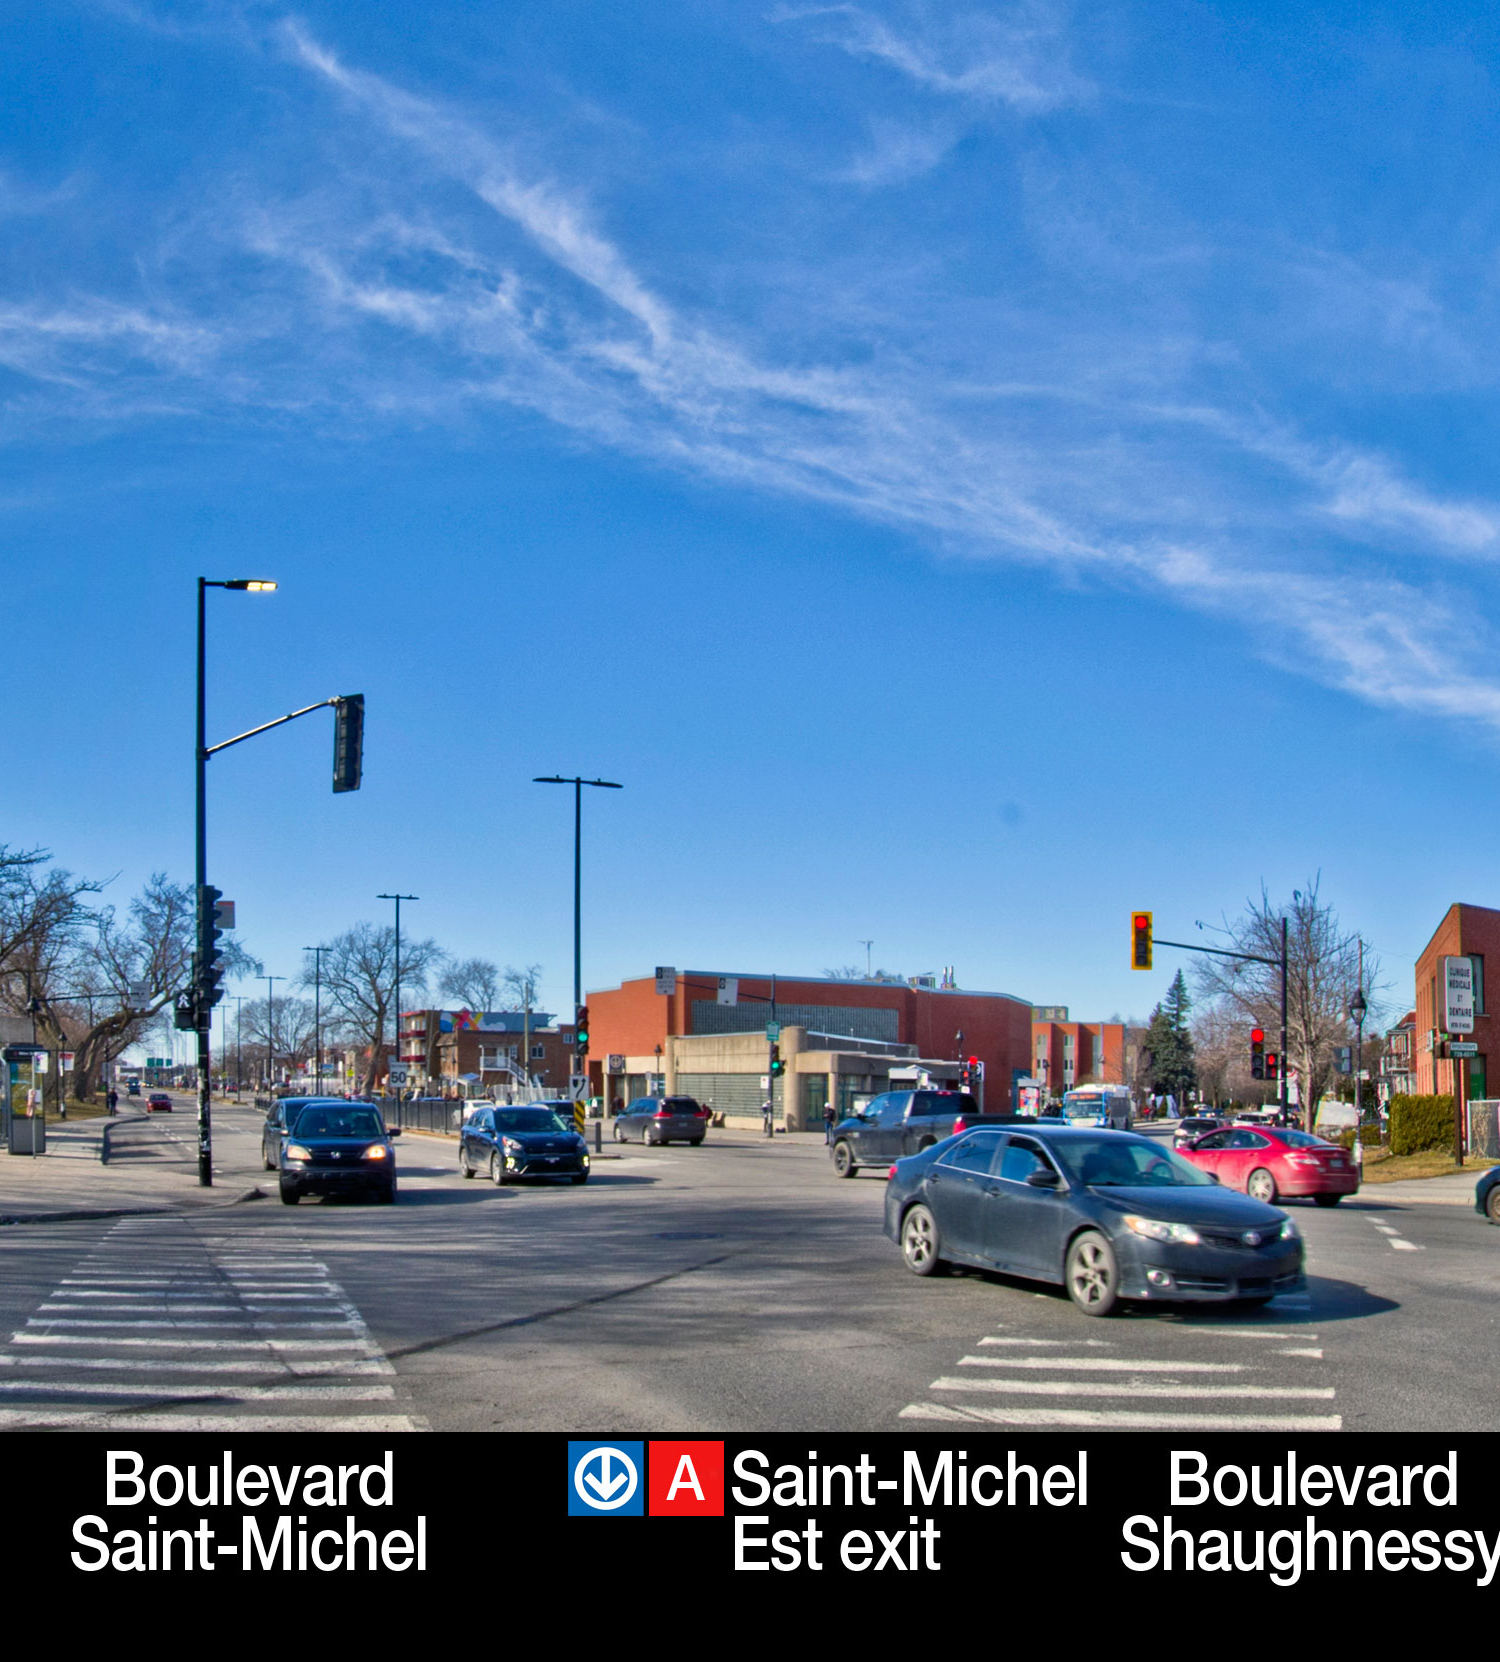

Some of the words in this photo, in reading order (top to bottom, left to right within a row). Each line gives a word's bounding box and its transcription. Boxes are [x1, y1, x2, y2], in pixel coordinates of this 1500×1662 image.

[1449, 967, 1471, 978] CLINIQUE
[1457, 994, 1463, 1003] ET
[1449, 1006, 1472, 1018] DENTAIRE
[391, 1071, 407, 1084] 50
